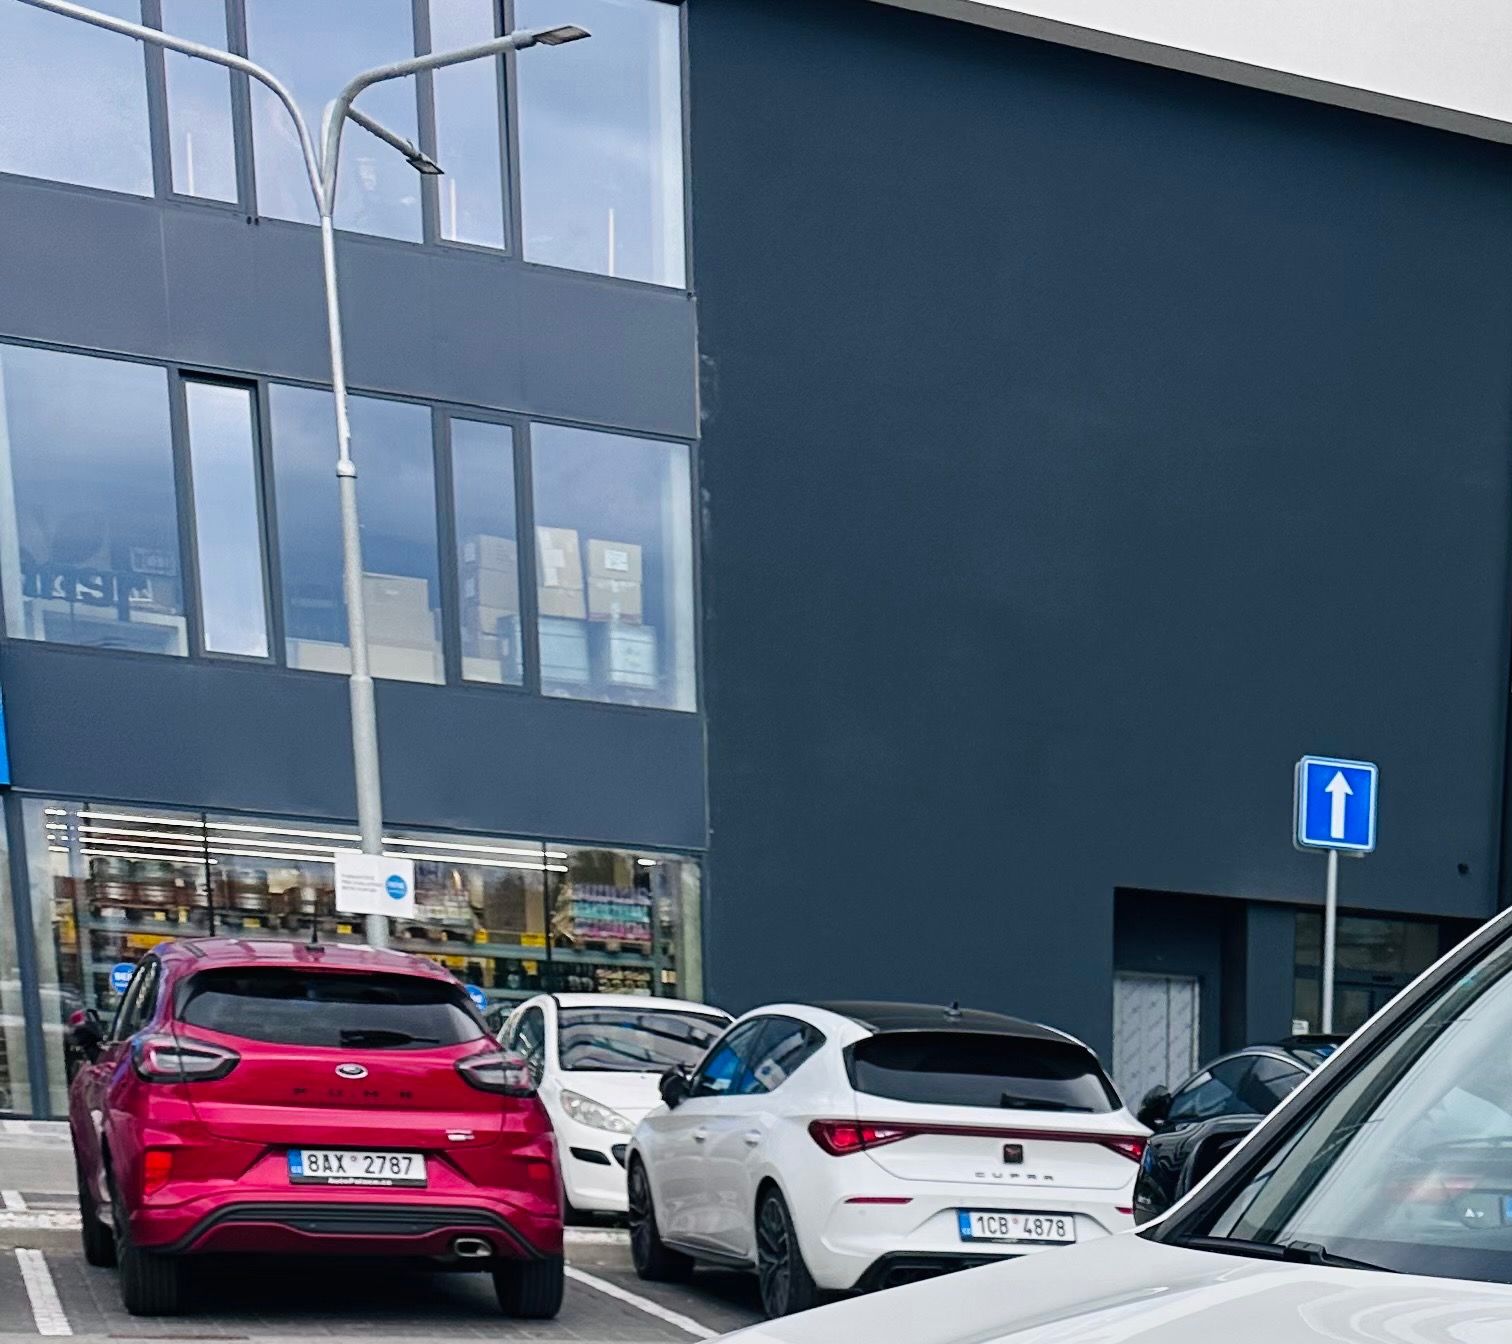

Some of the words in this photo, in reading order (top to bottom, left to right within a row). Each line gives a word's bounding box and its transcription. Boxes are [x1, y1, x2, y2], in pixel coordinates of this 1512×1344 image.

[307, 1154, 346, 1173] 8AX
[363, 1155, 412, 1175] 2787
[977, 1216, 1009, 1235] 1CB
[1023, 1217, 1066, 1237] 4878
